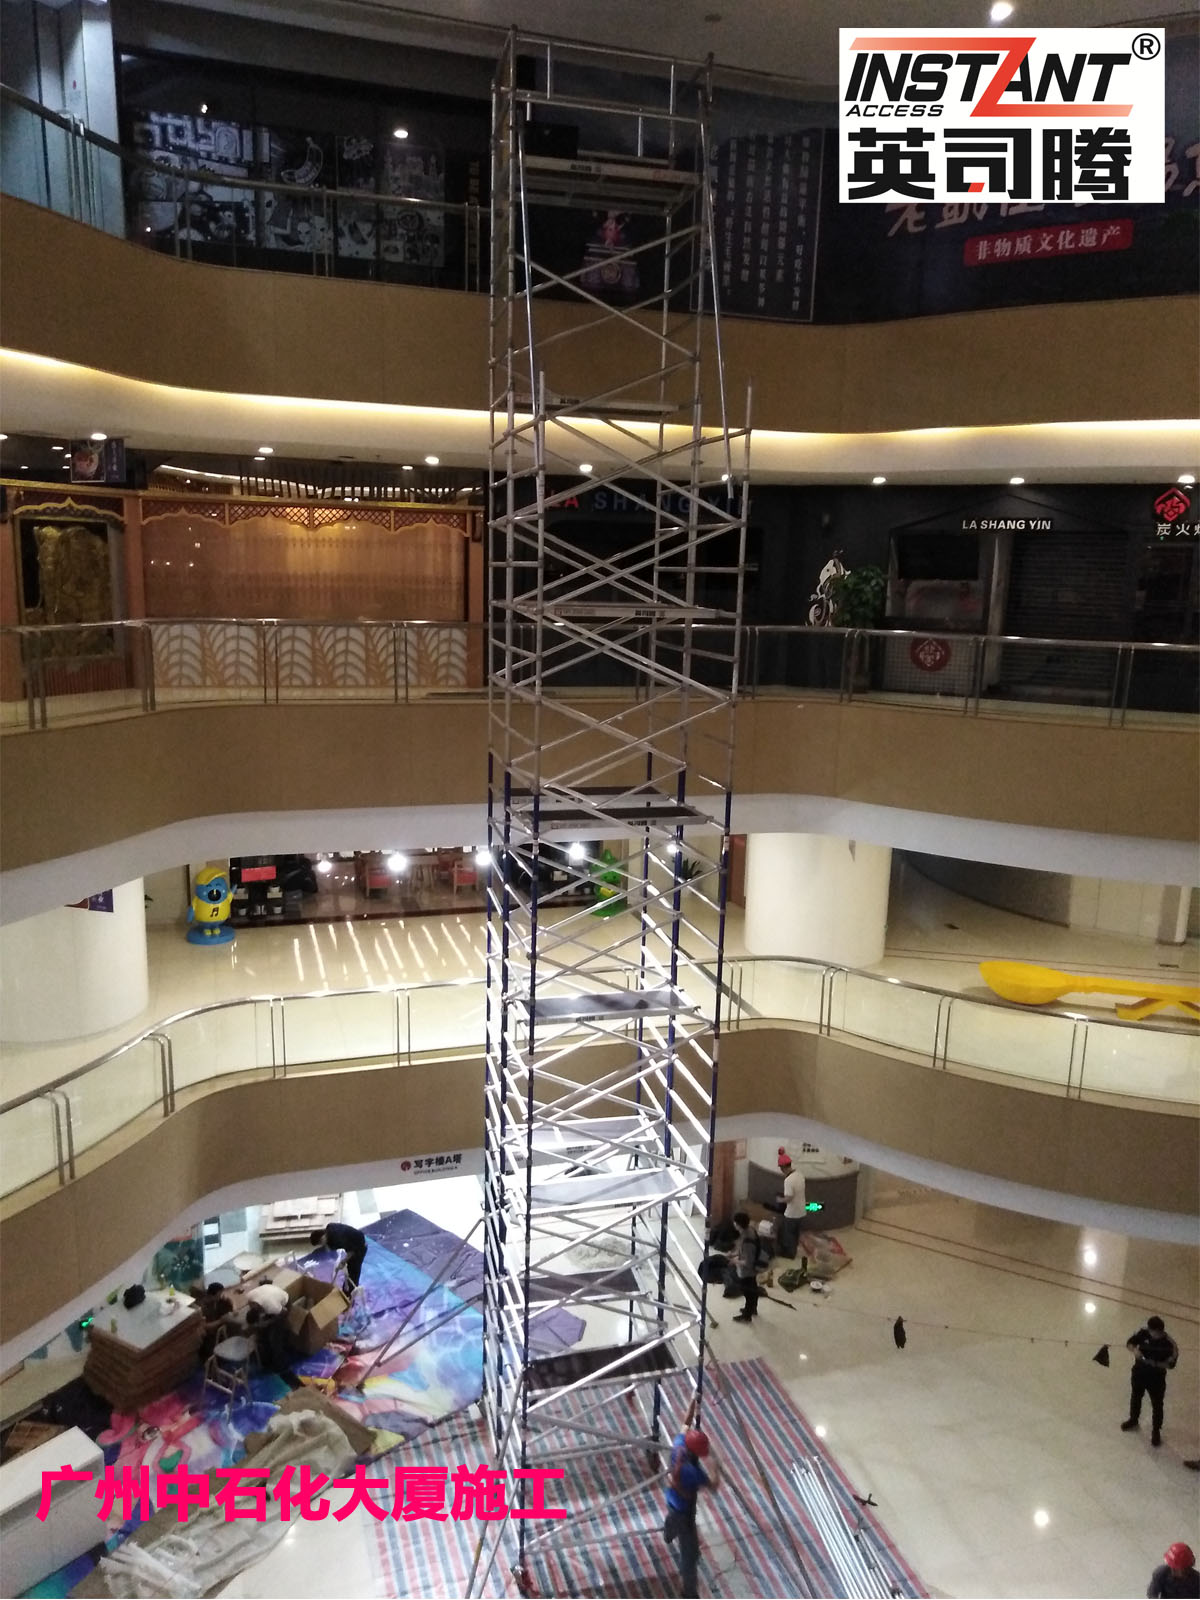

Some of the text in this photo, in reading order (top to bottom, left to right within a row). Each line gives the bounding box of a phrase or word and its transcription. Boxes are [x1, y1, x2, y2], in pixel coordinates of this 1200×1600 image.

[976, 226, 1121, 261] 非物质文化遗产
[962, 519, 1052, 530] LA SHANG YIN
